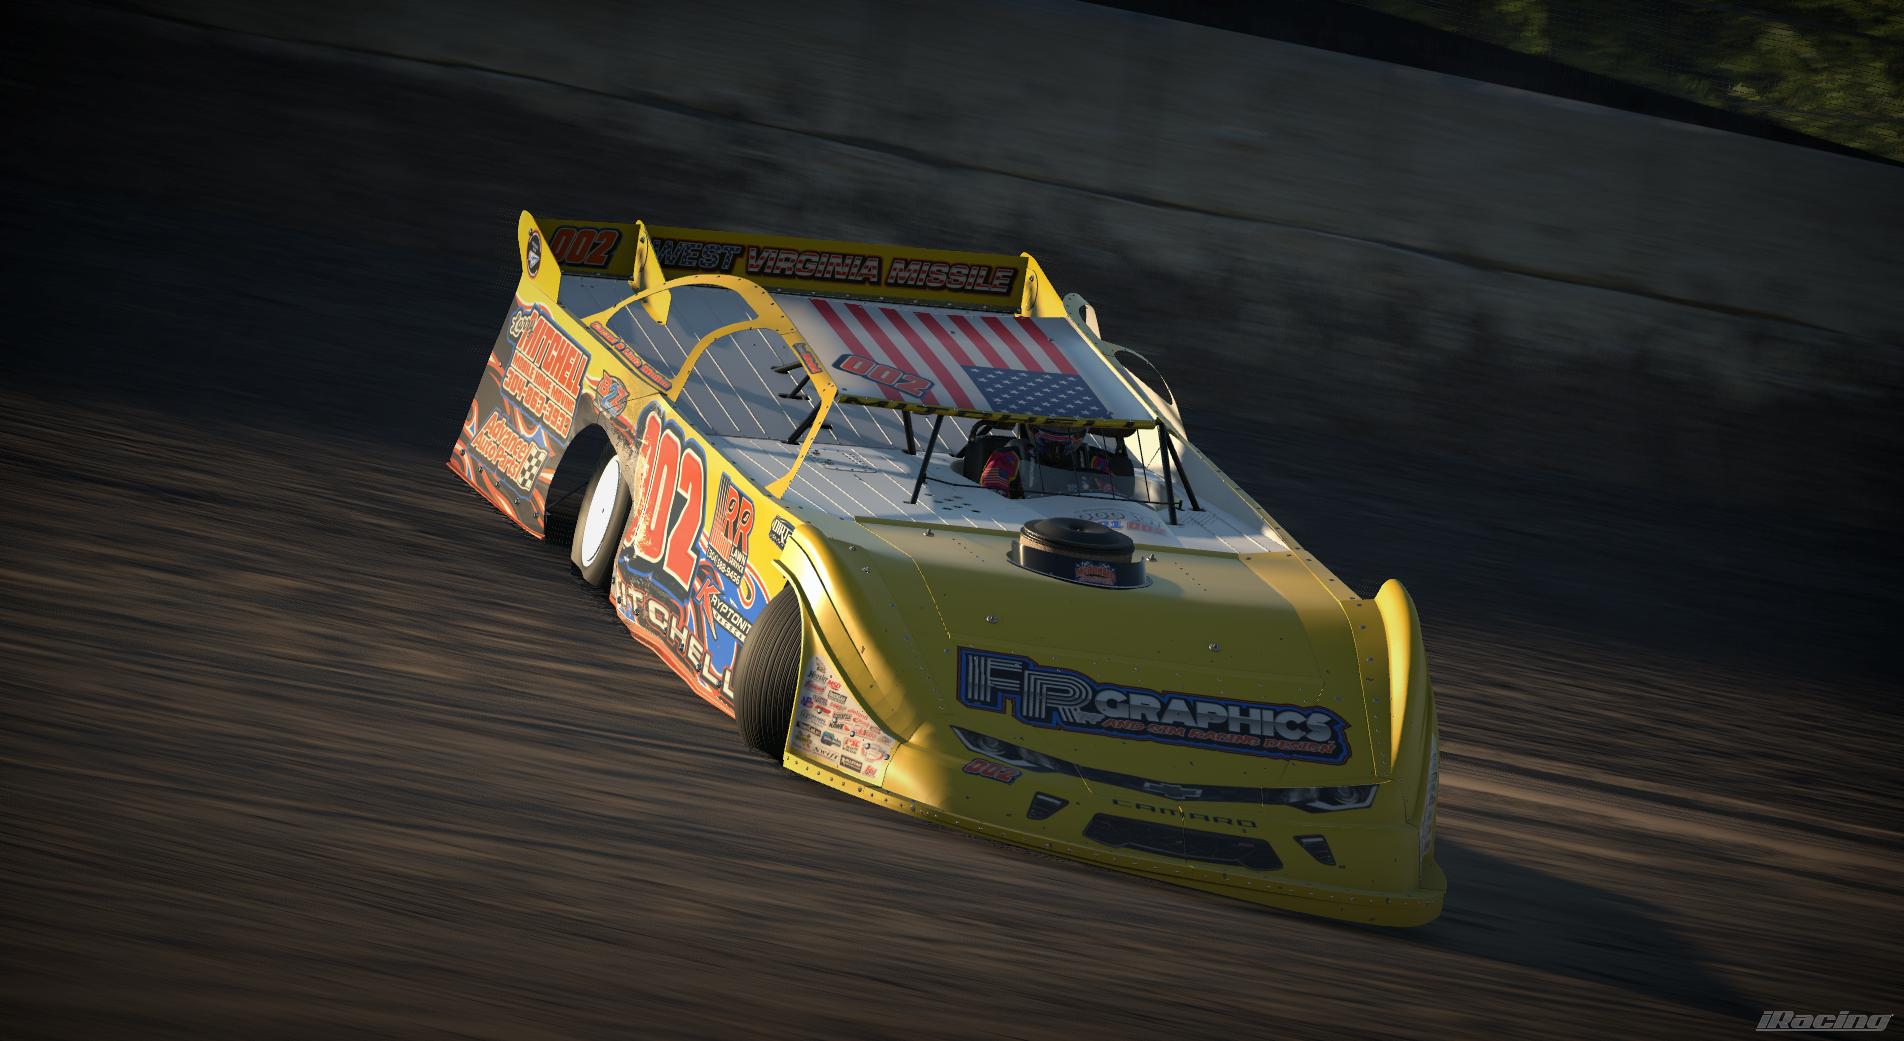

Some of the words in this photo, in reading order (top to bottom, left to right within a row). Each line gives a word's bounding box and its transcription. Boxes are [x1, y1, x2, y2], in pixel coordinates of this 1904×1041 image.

[552, 228, 619, 267] 002
[651, 238, 742, 271] WEST
[747, 248, 879, 283] VIRGINIA
[887, 259, 1014, 293] MISSILE
[510, 348, 536, 382] MOBILE
[532, 367, 553, 396] HOME
[548, 382, 577, 417] MOVING
[516, 309, 588, 399] MITCHELL
[840, 354, 931, 397] 002
[480, 410, 533, 462] Advance
[624, 410, 704, 592] 002
[724, 484, 754, 555] RR
[731, 546, 747, 565] LAWN
[616, 577, 734, 699] ITCHELL
[697, 578, 752, 640] KRYPTONIT
[967, 654, 1096, 725] FR
[1095, 690, 1333, 743] GRAPHICS
[1102, 718, 1145, 732] AND
[1147, 723, 1185, 737] SIM
[1188, 728, 1261, 747] RACING
[1263, 738, 1337, 754] DESIGN
[967, 758, 1019, 783] 002
